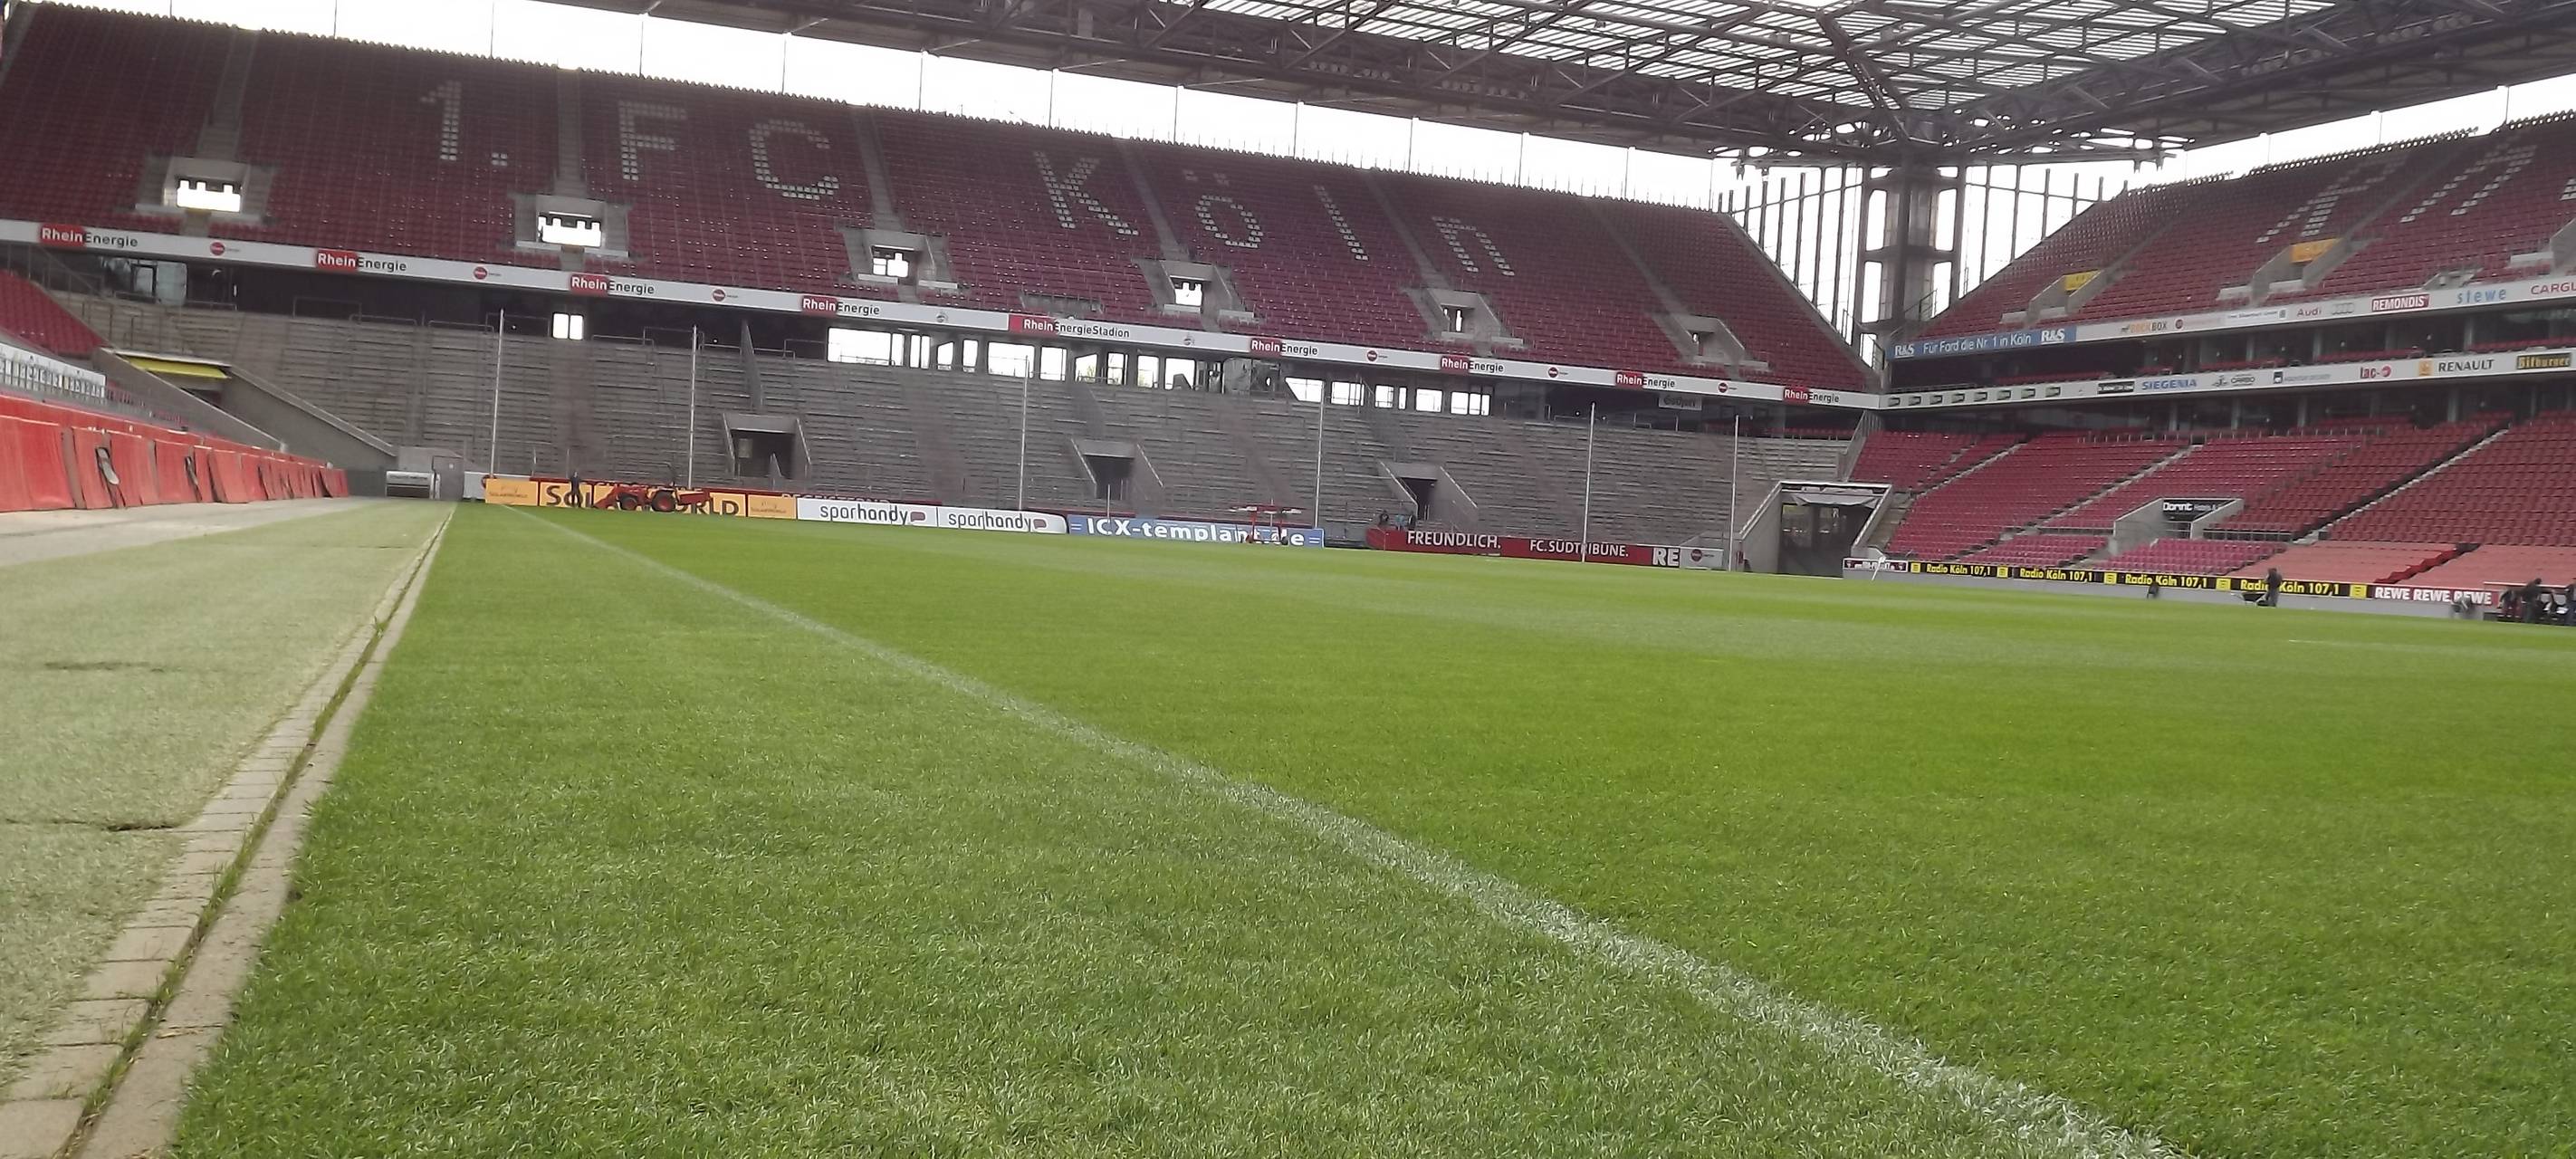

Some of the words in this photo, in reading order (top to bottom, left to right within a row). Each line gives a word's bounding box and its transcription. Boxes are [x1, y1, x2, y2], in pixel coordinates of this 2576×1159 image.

[618, 100, 839, 201] FC
[1033, 150, 1515, 276] Köln
[42, 227, 138, 248] RheinEnergie
[318, 253, 407, 273] RheinEnergie
[571, 276, 655, 295] RheinEnergie
[803, 298, 880, 316] RheinEnergie
[2372, 296, 2426, 311] REMONDIS
[2296, 307, 2322, 317] Audi
[1251, 340, 1318, 356] RheinEnergie
[1939, 340, 1958, 352] Ford
[2010, 332, 2031, 345] Köln
[2041, 328, 2064, 343] R&S
[1441, 357, 1504, 373] RheinEnergie
[2438, 359, 2495, 372] RENAULT
[1616, 373, 1675, 389] RheinEnergie
[1785, 388, 1839, 404] RheinEnergie
[820, 503, 908, 525] sparhandy
[948, 511, 1031, 532] sparhandy
[1407, 531, 1501, 549] FREUNDLICH.
[1652, 547, 1680, 566] RE
[1949, 563, 1968, 575] Köln
[2046, 568, 2066, 580] Köln
[2156, 574, 2177, 587] Köln
[2375, 587, 2409, 599] REWE
[2413, 589, 2450, 601] REWE
